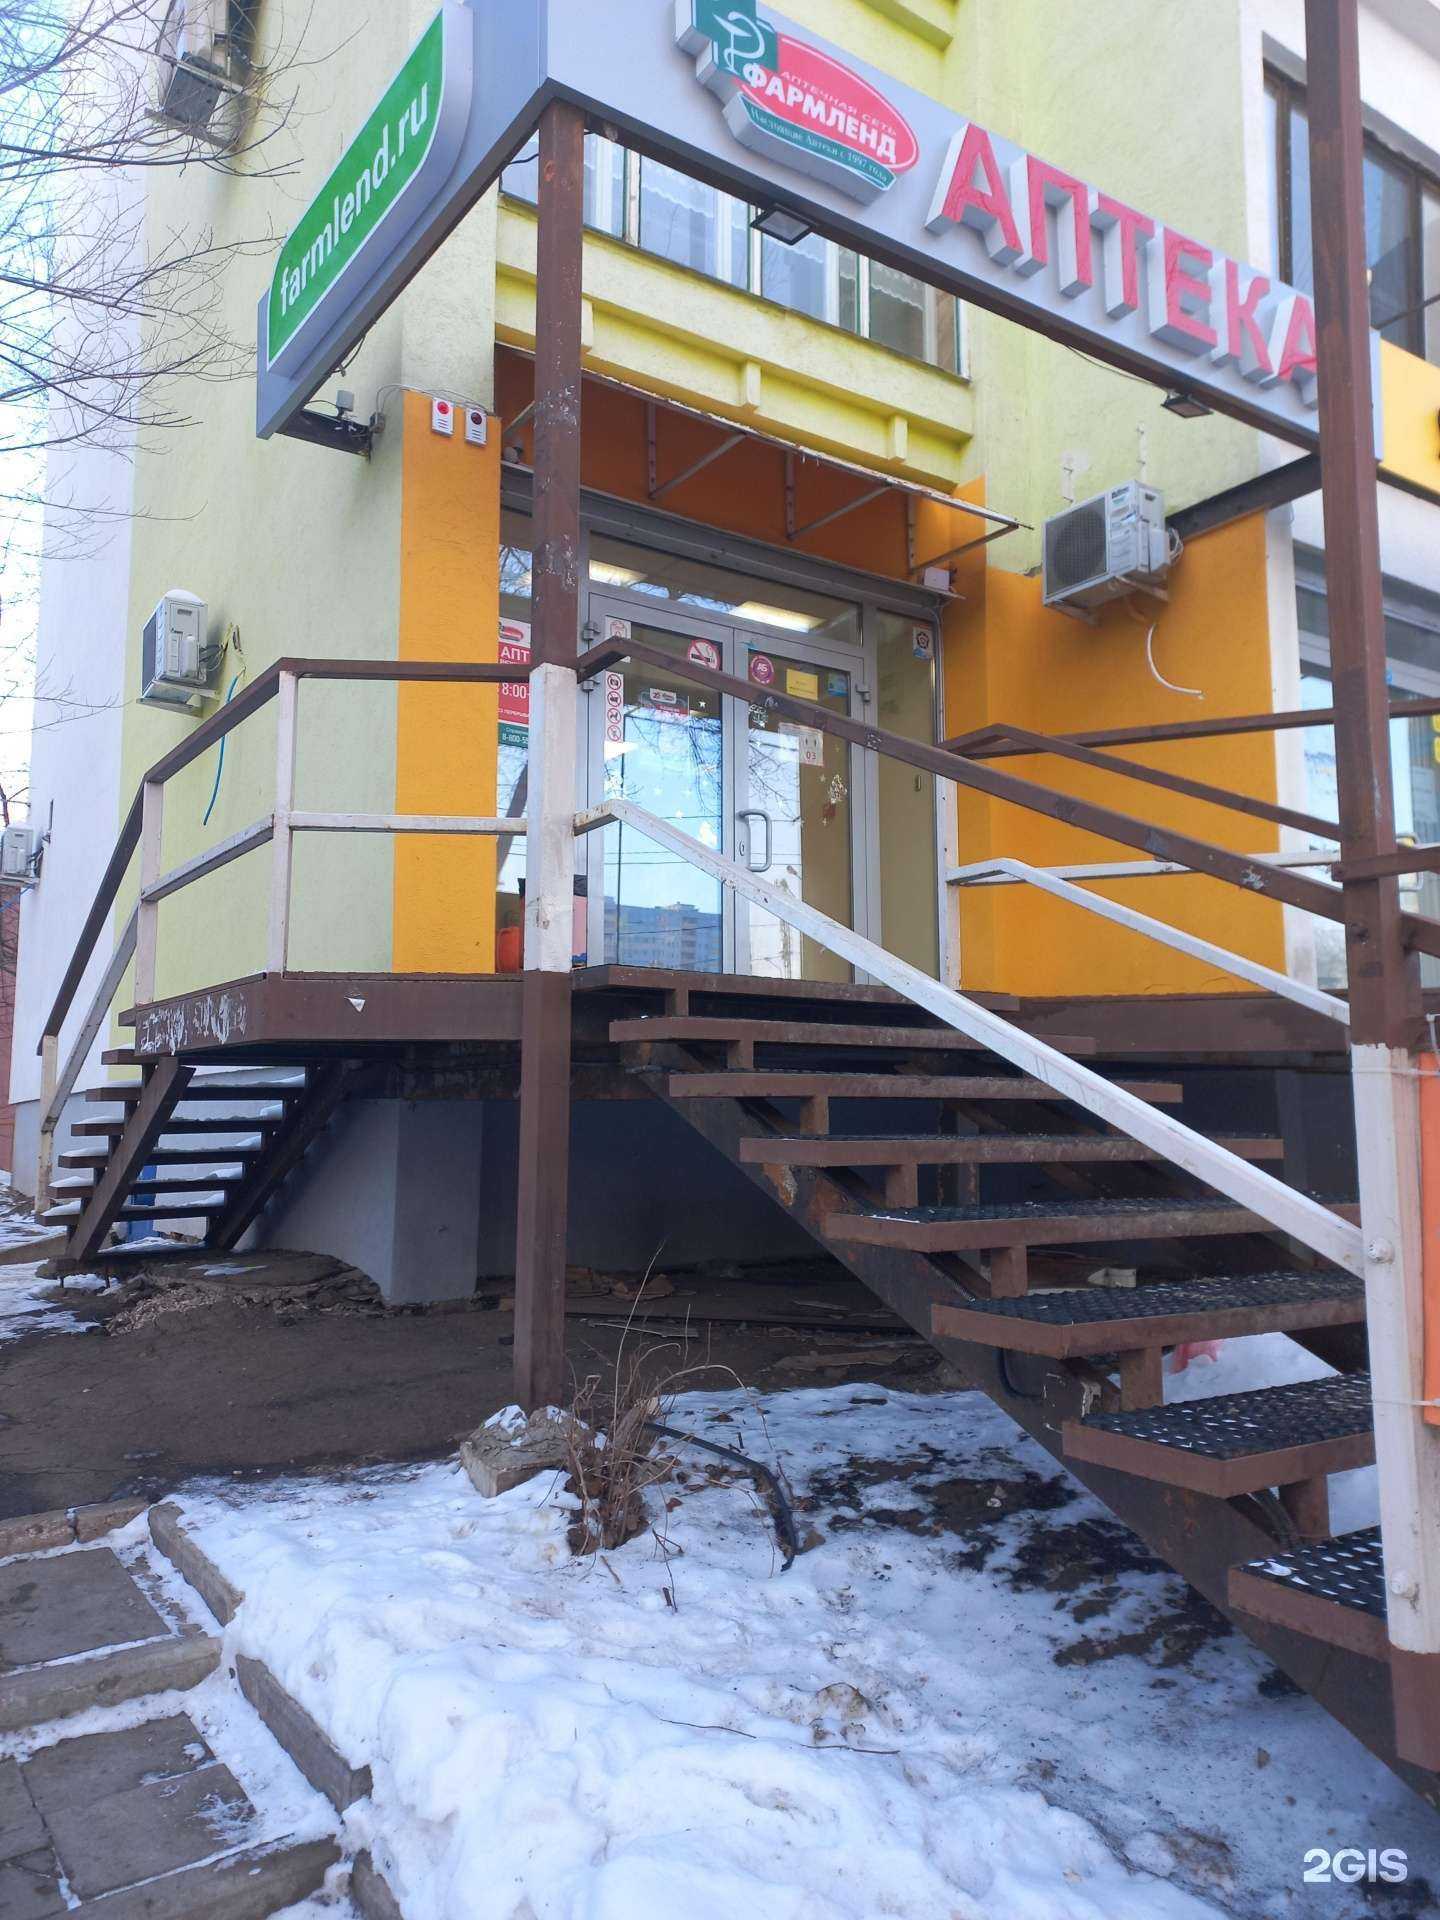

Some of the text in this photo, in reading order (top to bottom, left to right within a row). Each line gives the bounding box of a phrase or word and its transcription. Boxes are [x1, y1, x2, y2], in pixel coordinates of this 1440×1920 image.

[742, 62, 897, 165] ФАРМЛЕНД
[280, 81, 428, 317] farmlend.ru
[938, 122, 1317, 383] АПТЕКА
[501, 646, 530, 663] АПТ
